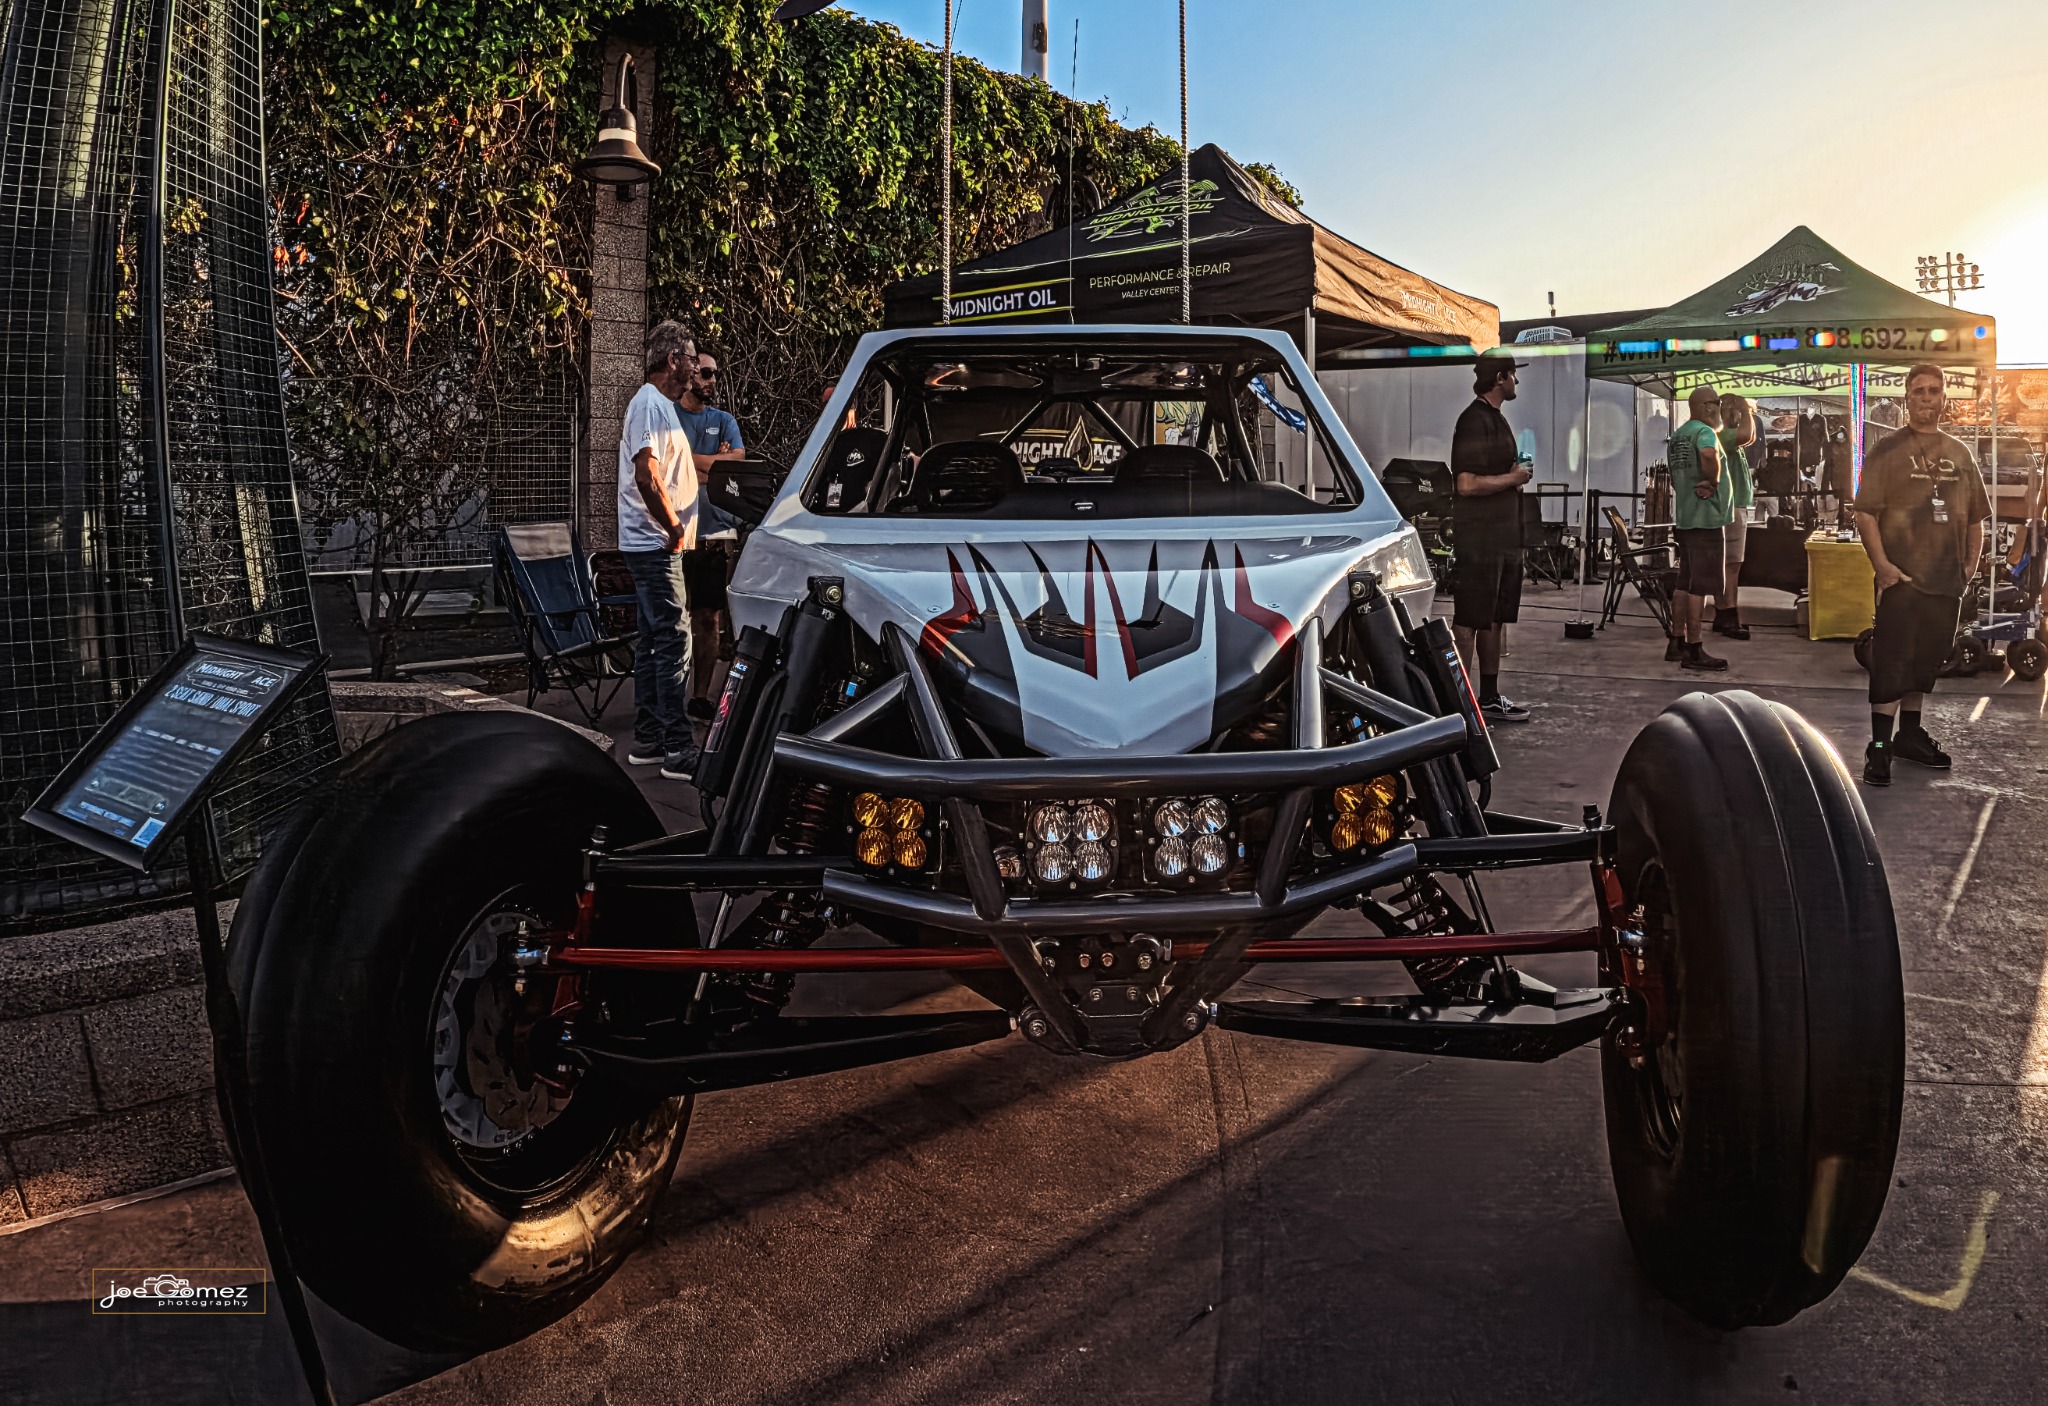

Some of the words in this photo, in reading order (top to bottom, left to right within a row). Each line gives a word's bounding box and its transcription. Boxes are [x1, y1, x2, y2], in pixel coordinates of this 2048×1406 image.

[1089, 204, 1181, 225] MIDNIGHT
[1186, 202, 1215, 211] OIL
[1089, 268, 1174, 289] PERFORMANCE
[1188, 262, 1231, 277] REPAIR
[949, 292, 1024, 316] MIDNIGHT
[1028, 289, 1056, 307] OIL
[1121, 289, 1148, 299] VALLEY
[1149, 286, 1180, 296] CENTER
[1805, 326, 1977, 351] 88.692.71
[1094, 443, 1122, 464] ACE
[196, 663, 245, 679] MIDNIGHT
[251, 676, 277, 687] ACE
[209, 696, 236, 712] DUAL
[229, 700, 262, 717] SPORT
